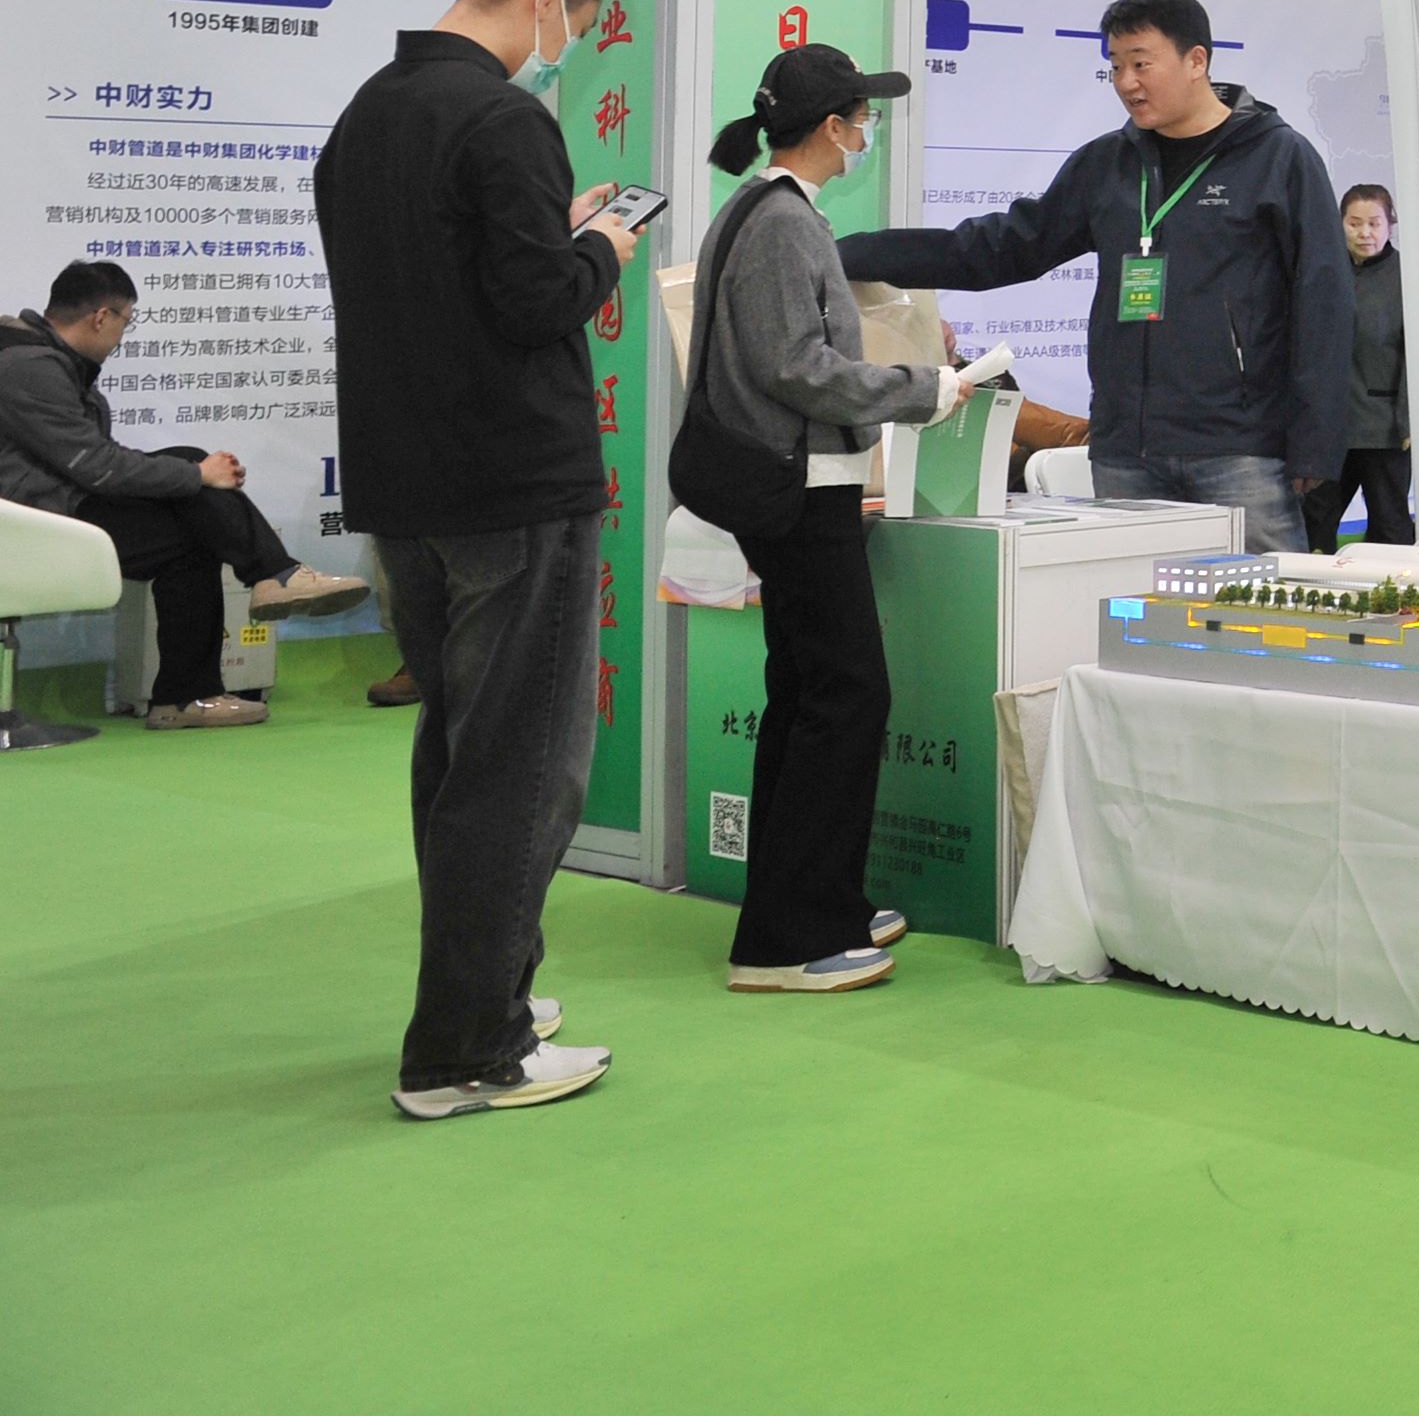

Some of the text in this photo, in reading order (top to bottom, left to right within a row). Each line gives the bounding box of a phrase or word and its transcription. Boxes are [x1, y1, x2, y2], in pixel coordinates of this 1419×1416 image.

[168, 12, 319, 38] 1995年集团创建
[95, 83, 212, 111] 中财实力
[320, 511, 344, 537] 营
